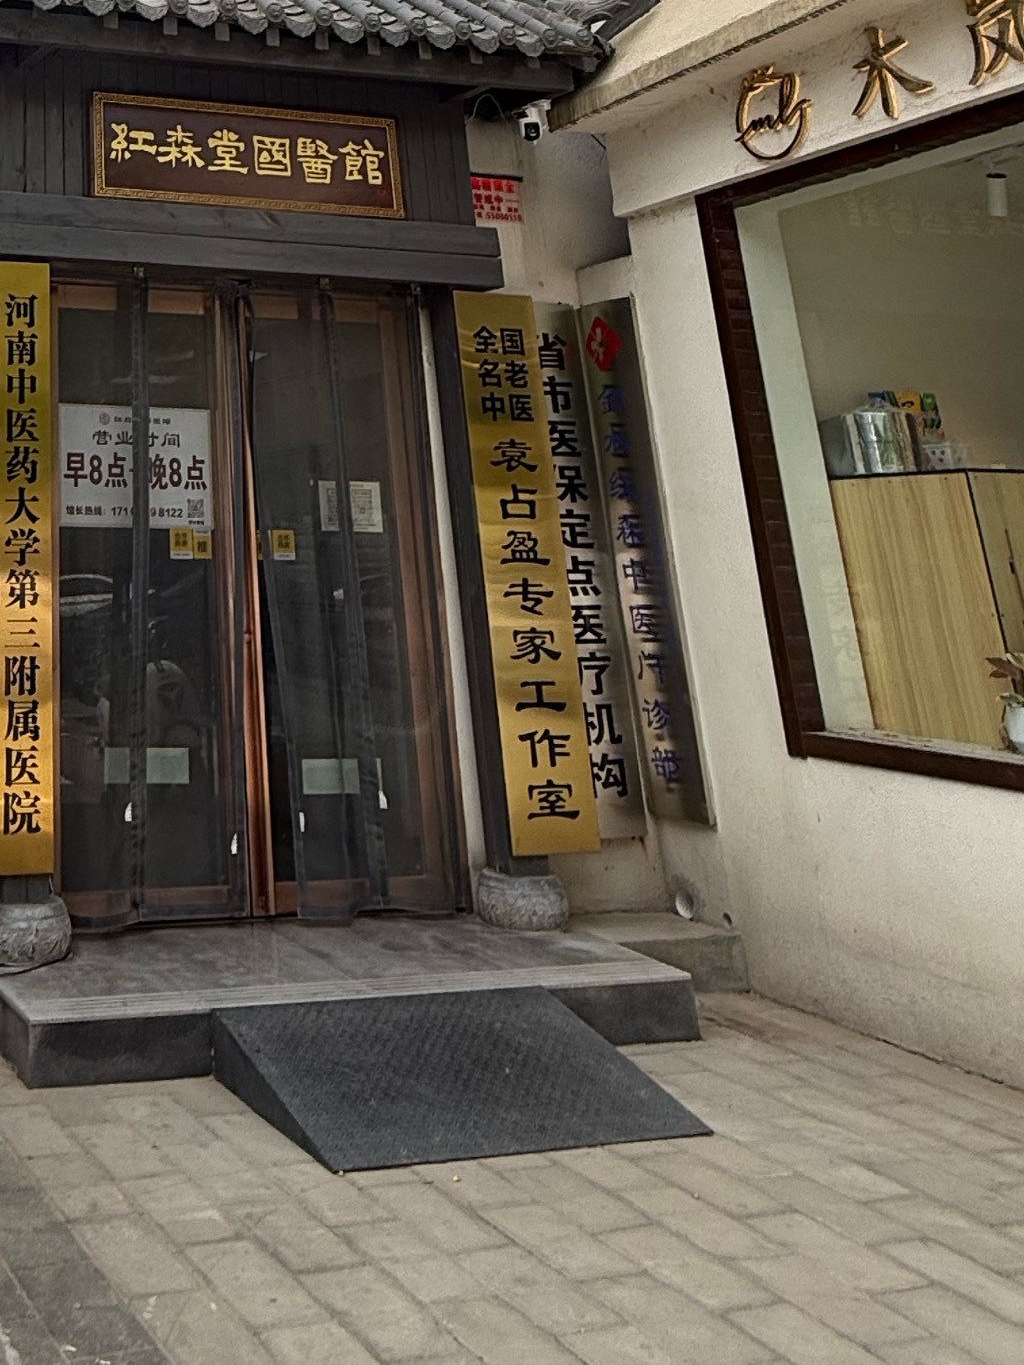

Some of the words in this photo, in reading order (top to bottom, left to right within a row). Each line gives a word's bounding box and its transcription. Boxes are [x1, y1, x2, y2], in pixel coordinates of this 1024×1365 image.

[473, 325, 526, 357] 全国
[478, 359, 529, 389] 名老
[481, 393, 535, 423] 中医
[63, 451, 208, 491] 早8点晚8点
[2, 292, 43, 836] 河南中医药大学第三附属医院
[490, 438, 580, 822] 袁占盈专家工作室
